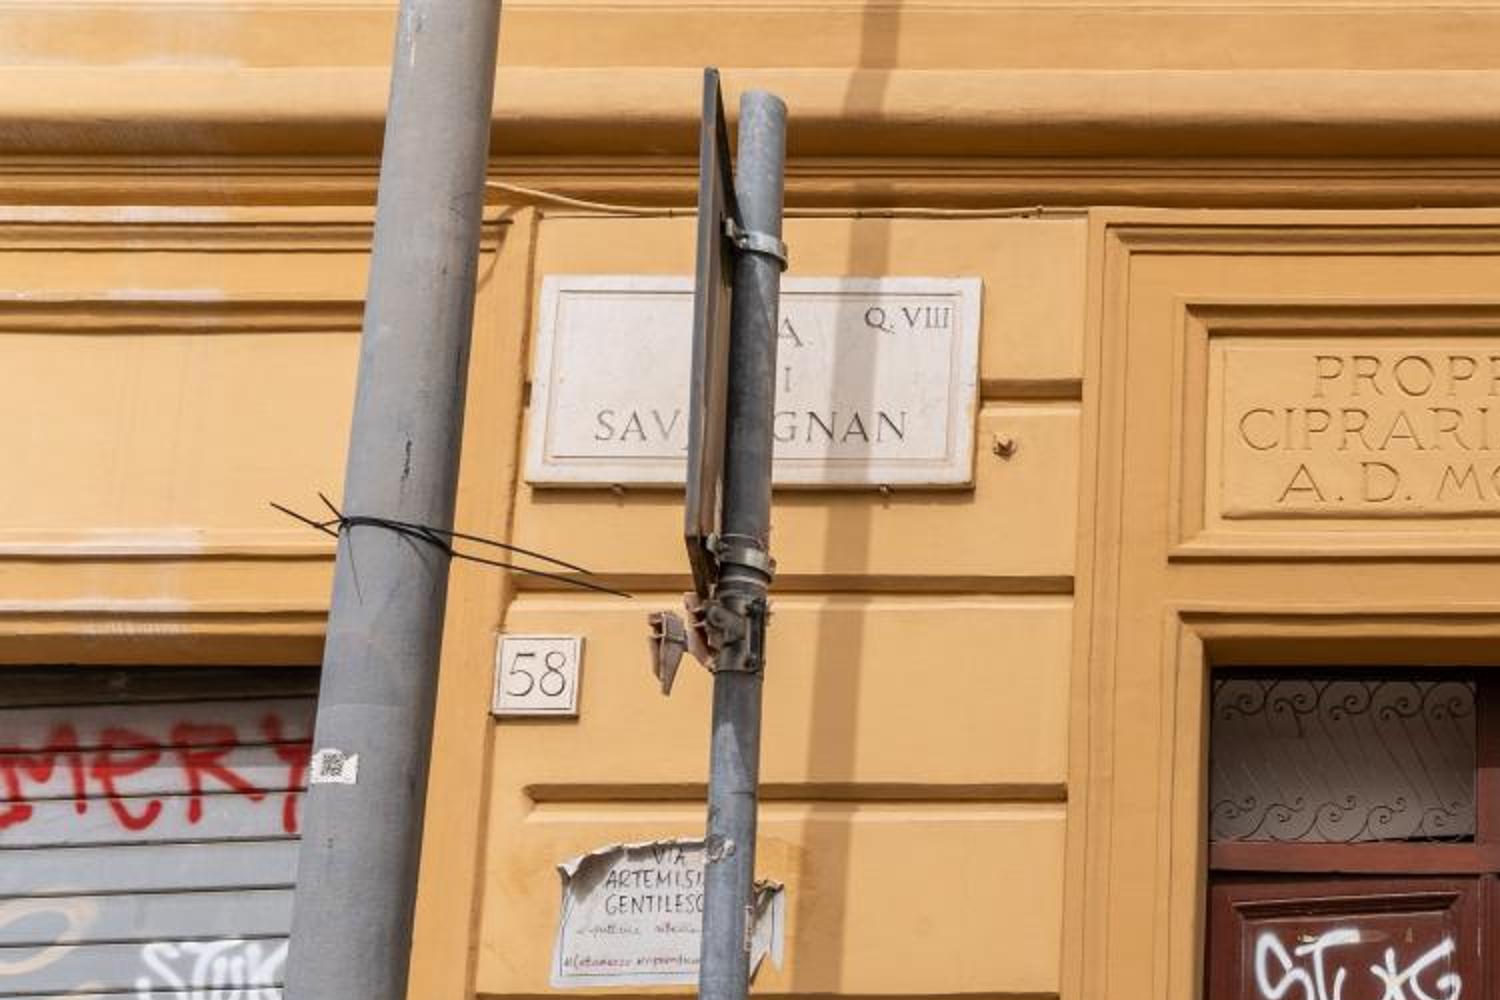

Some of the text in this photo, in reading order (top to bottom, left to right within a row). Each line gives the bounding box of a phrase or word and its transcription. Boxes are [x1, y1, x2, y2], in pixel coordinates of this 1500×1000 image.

[901, 306, 949, 329] VIII
[594, 408, 906, 446] SAVGNAN
[505, 652, 567, 697] 58
